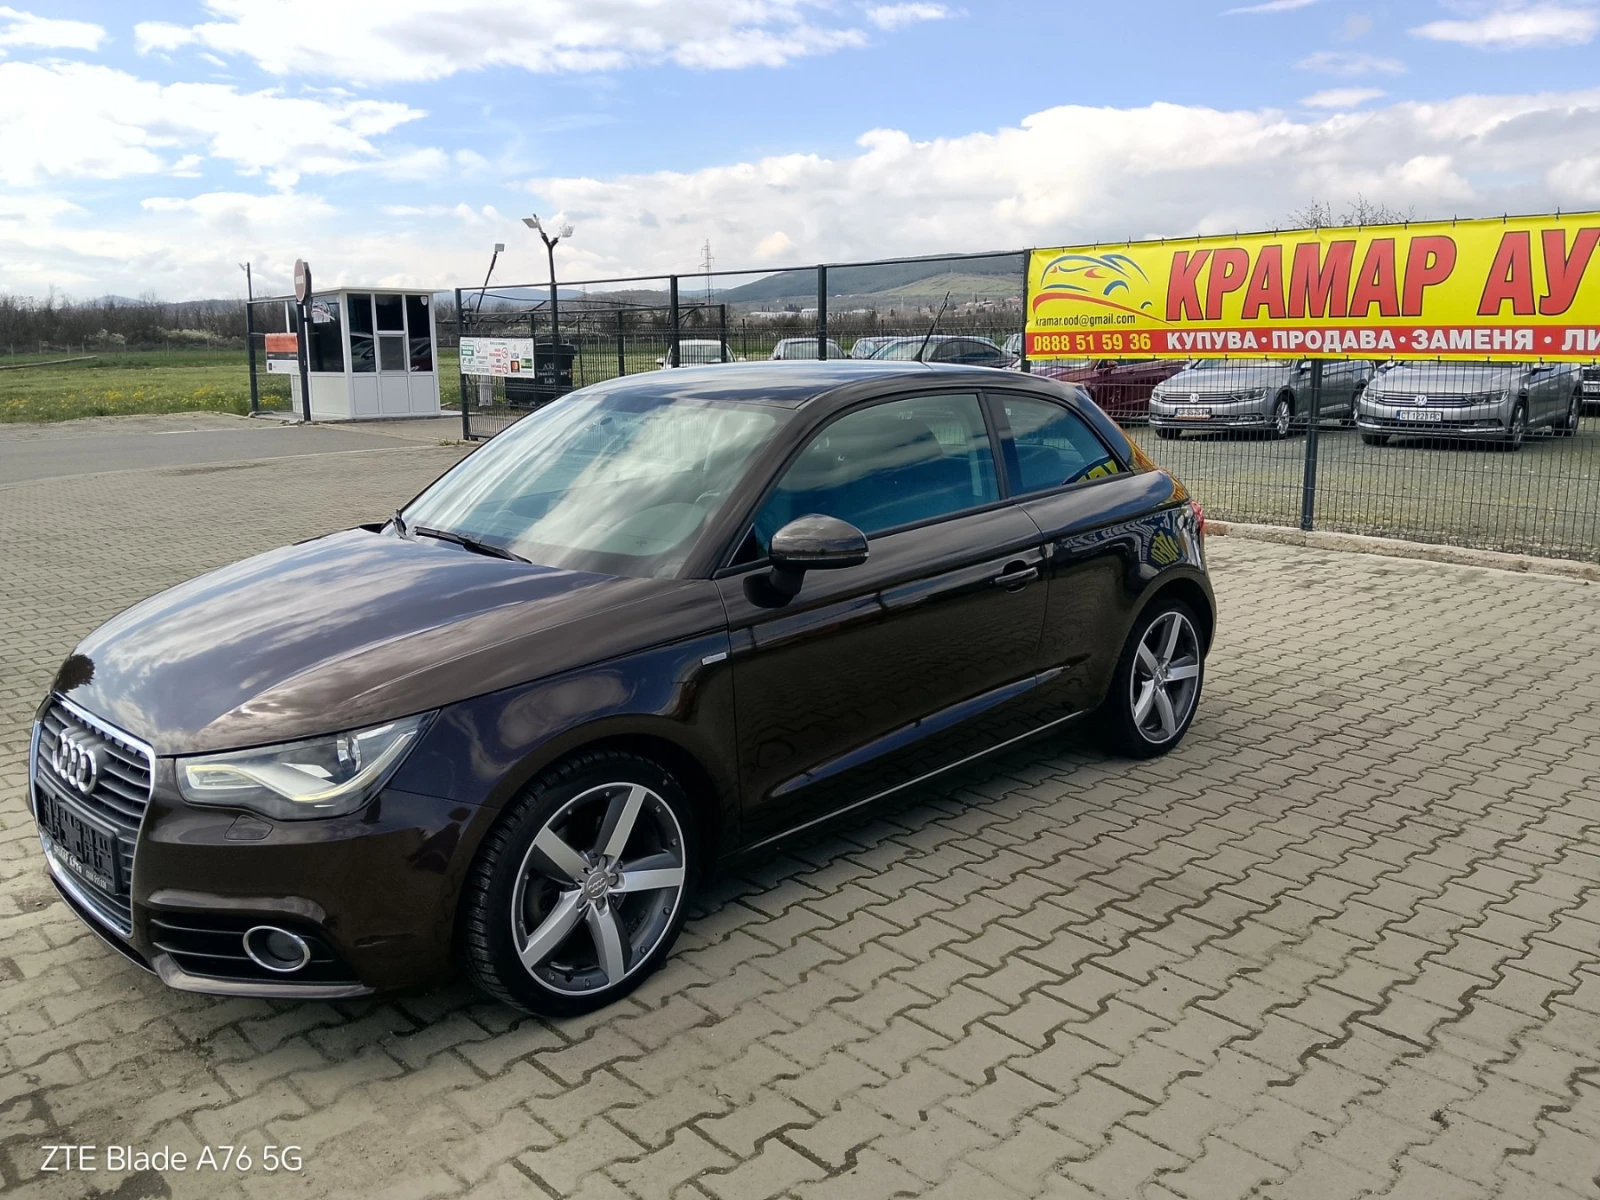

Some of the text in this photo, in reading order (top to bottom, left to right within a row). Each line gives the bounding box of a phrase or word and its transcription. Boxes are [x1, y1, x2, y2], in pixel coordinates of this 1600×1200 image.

[1166, 228, 1600, 320] КРАМАР АУ
[1035, 313, 1135, 328] kramar.ood@gmail.com
[1034, 333, 1151, 351] 0888 51 59 36
[1166, 331, 1258, 350] КУПУВА
[1272, 330, 1396, 353] ПРОДАВА
[1411, 329, 1534, 350] ЗАМЕНЯ
